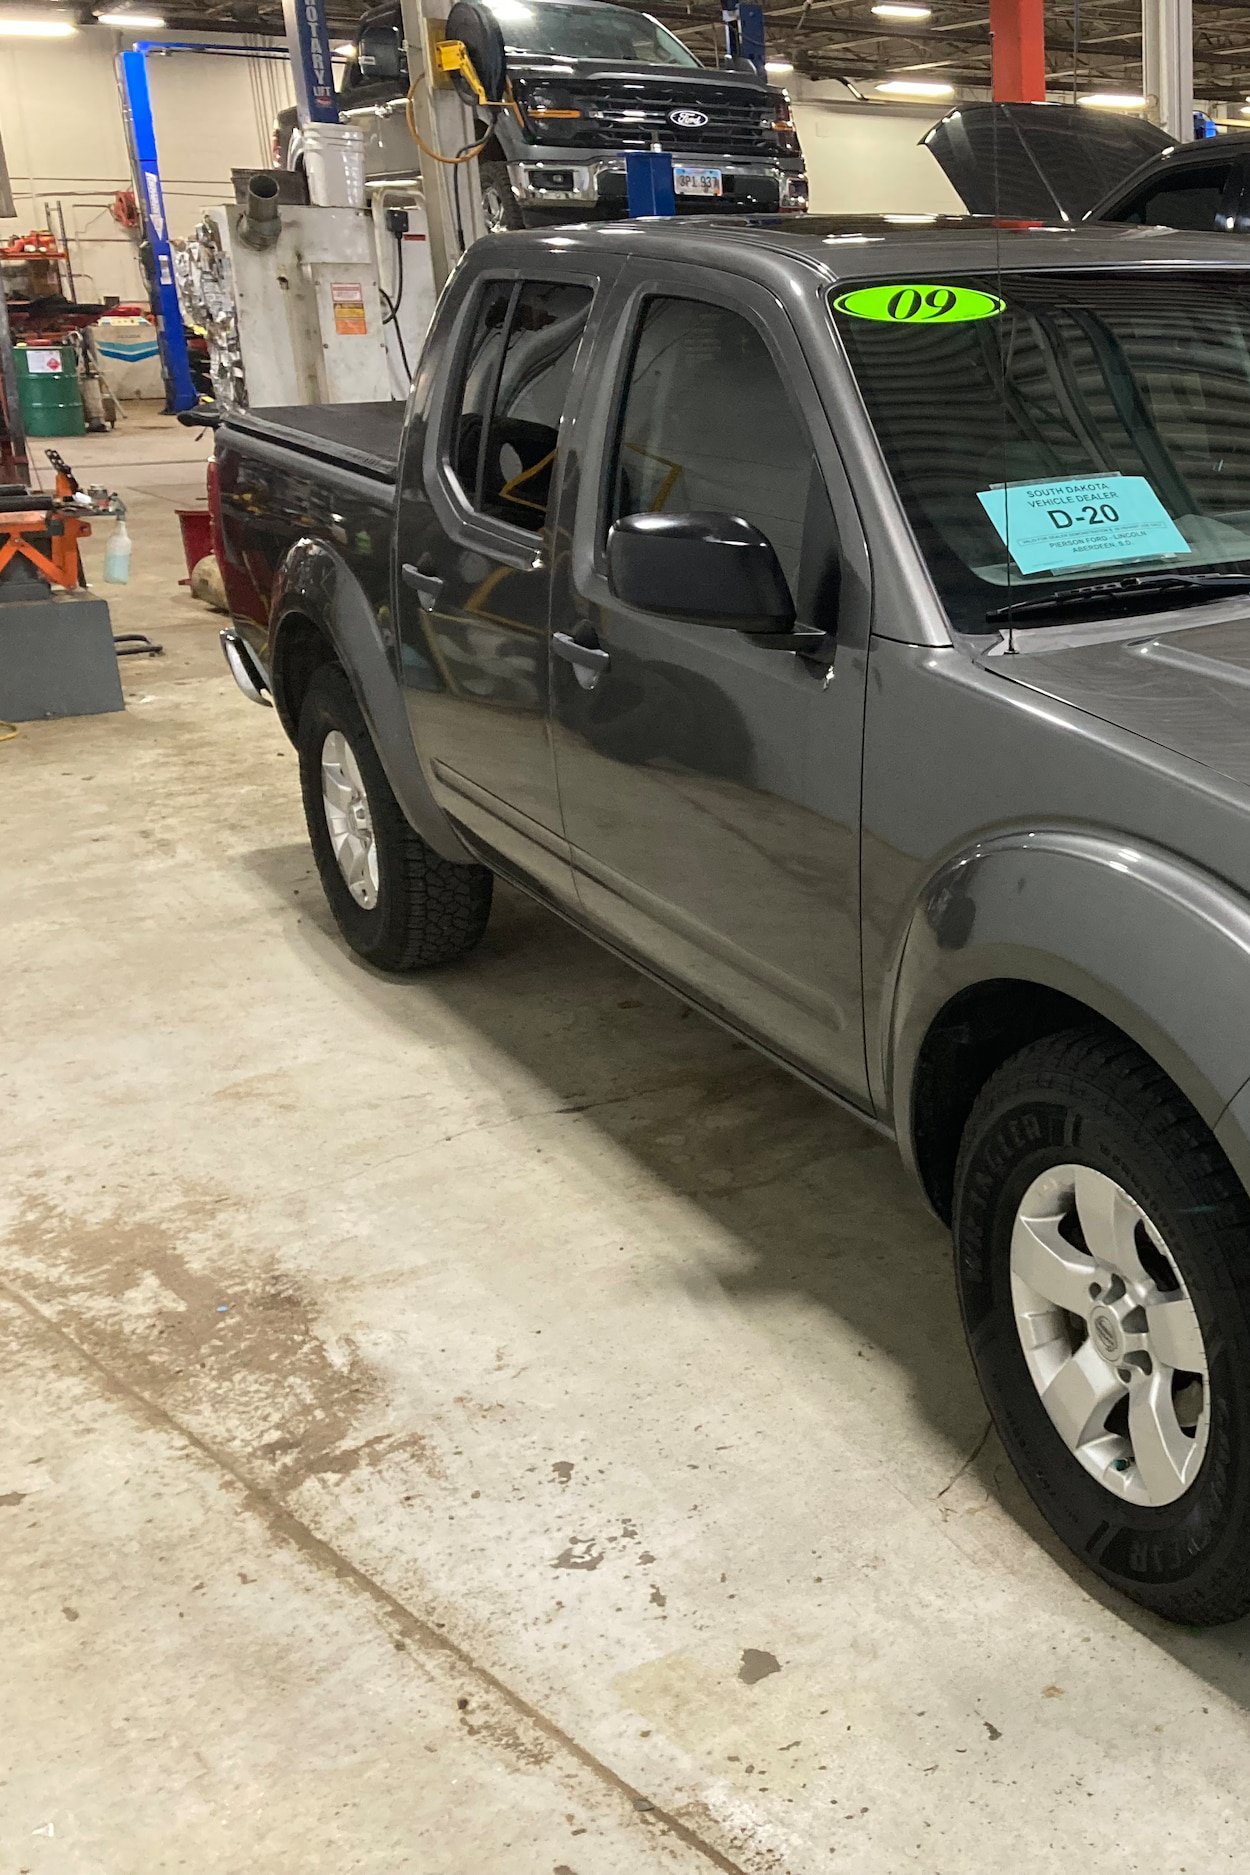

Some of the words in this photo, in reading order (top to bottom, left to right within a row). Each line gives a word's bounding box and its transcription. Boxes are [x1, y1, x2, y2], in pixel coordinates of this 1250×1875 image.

[887, 288, 957, 320] 09
[1026, 487, 1064, 498] SOUTH
[1065, 483, 1110, 494] DAKOTA
[1027, 496, 1075, 508] VEHICLE
[1075, 491, 1119, 502] DEALER
[1047, 504, 1119, 529] D-20
[1049, 538, 1085, 549] PIERSON
[1086, 535, 1108, 543] FORD
[1113, 531, 1148, 540] LINCOLN
